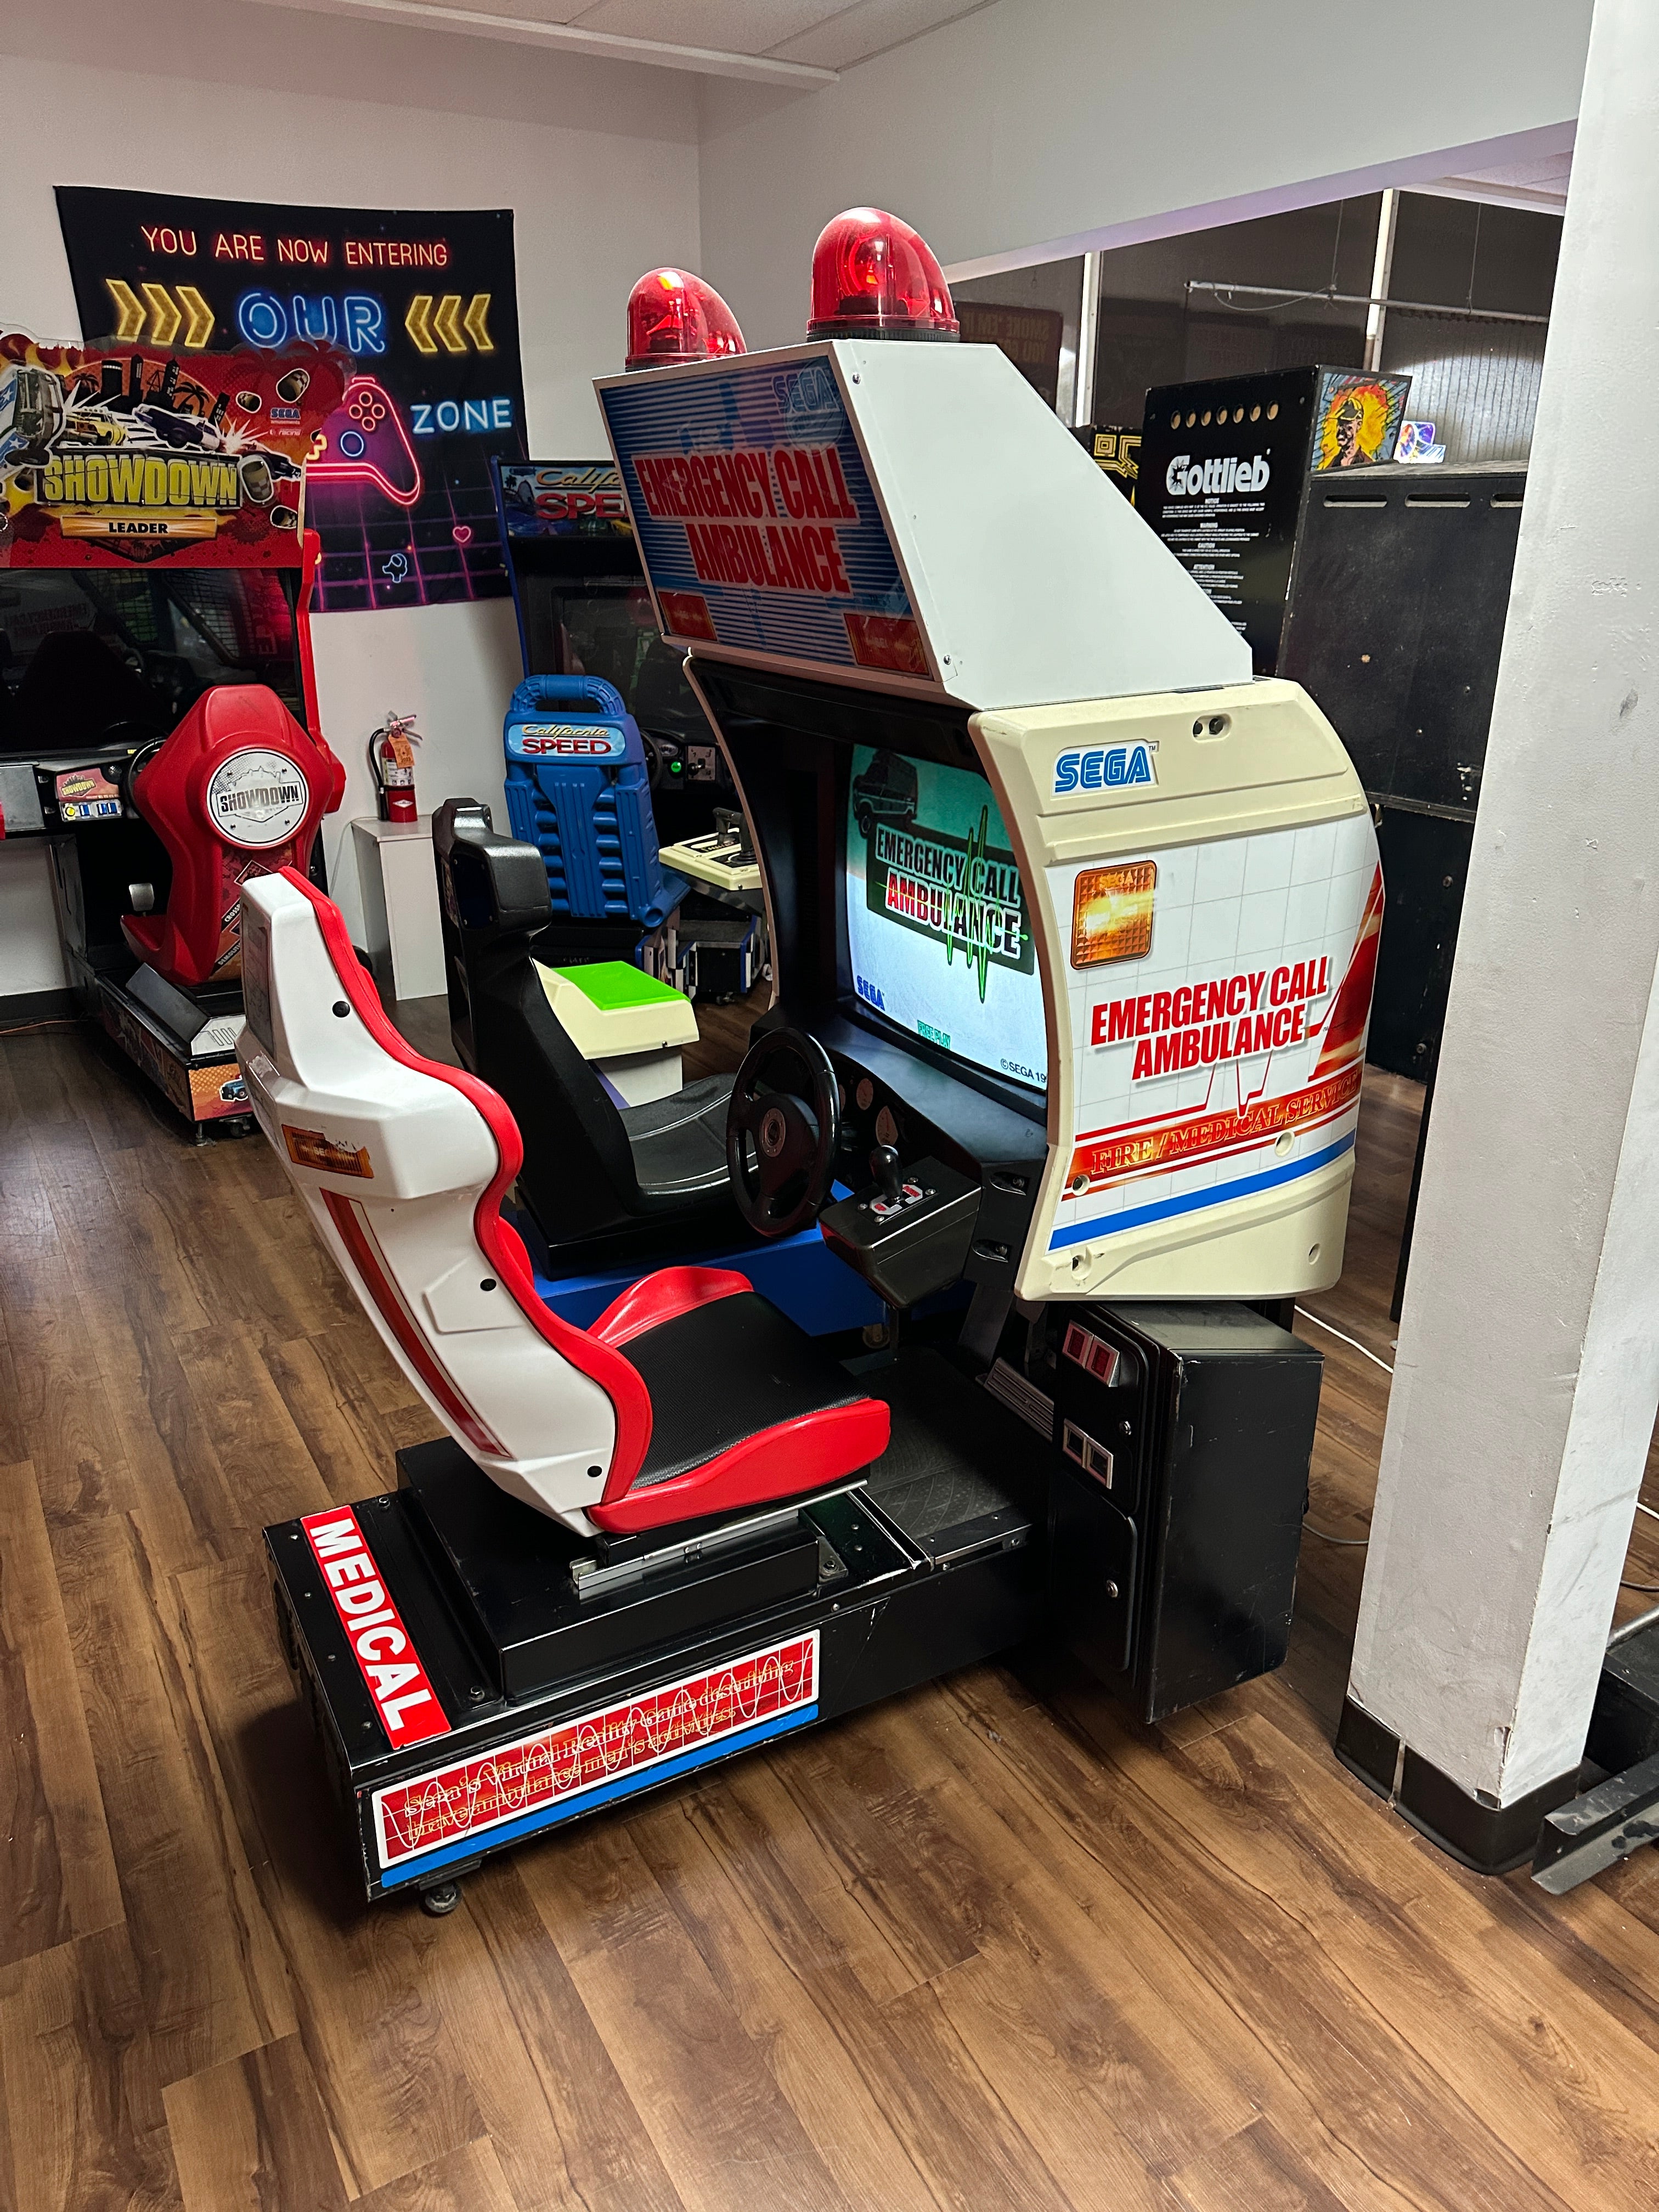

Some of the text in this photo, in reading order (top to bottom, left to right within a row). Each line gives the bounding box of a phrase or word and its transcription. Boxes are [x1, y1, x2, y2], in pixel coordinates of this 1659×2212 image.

[140, 225, 448, 267] YOU ARE NOW ENTERING
[239, 292, 386, 354] OUR
[772, 365, 840, 414] SEGA
[271, 408, 301, 419] SEGA
[410, 399, 512, 435] ZONE
[44, 454, 237, 505] SHOWDOWN
[633, 447, 857, 520] EMERGENCY CALL
[1166, 455, 1270, 495] Gottlieb
[109, 522, 168, 534] LEADER
[535, 493, 630, 520] SPE
[685, 523, 851, 594] AMBULANCE
[522, 725, 610, 739] California
[522, 738, 611, 754] SPEED
[61, 780, 95, 795] SHOWDOWN
[1055, 746, 1151, 793] SEGA
[220, 785, 300, 812] SHOWDOWN
[877, 823, 1020, 909] EMERGENCY CALL
[1099, 870, 1134, 888] SEGA
[885, 867, 1022, 959] AMBULANCE
[857, 975, 885, 1011] SEGA
[1091, 956, 1328, 1046] EMERGENCY CALL
[917, 1020, 951, 1049] FREE PLAY
[1132, 1003, 1306, 1080] AMBULANCE
[1091, 1134, 1154, 1175] FIRE
[1170, 1105, 1283, 1155] MEDICAL
[1285, 1072, 1359, 1122] SERVICE
[309, 1518, 432, 1731] MEDICAL
[483, 1745, 561, 1786] Virtual
[563, 1718, 636, 1754] Reality
[640, 1697, 697, 1727] Game
[699, 1660, 794, 1706] describing
[407, 1807, 469, 1840] brave
[470, 1767, 582, 1817] ambulance
[585, 1736, 645, 1774] men's
